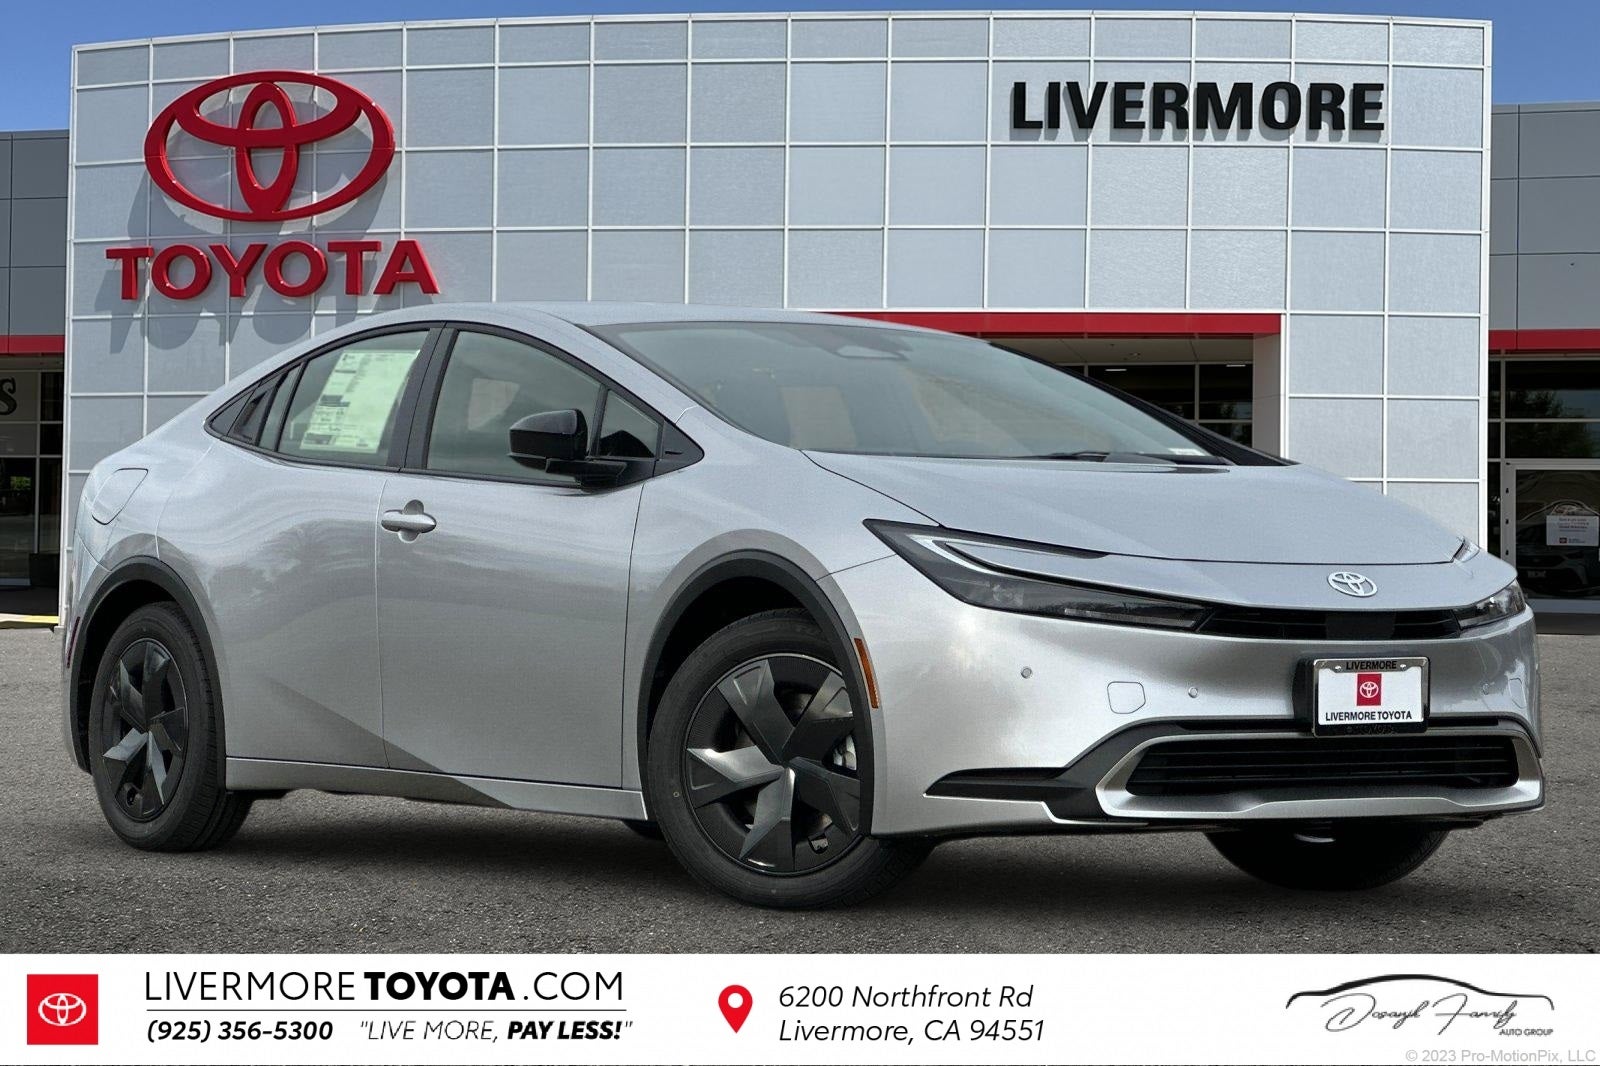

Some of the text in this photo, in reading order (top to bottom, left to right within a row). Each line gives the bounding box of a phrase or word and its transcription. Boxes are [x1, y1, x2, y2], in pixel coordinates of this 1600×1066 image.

[1011, 81, 1385, 131] LIVERMORE
[105, 239, 440, 300] TOYOTA
[1345, 660, 1397, 670] LIVERMORE
[1325, 710, 1412, 722] LIVERMORE TOYOTA
